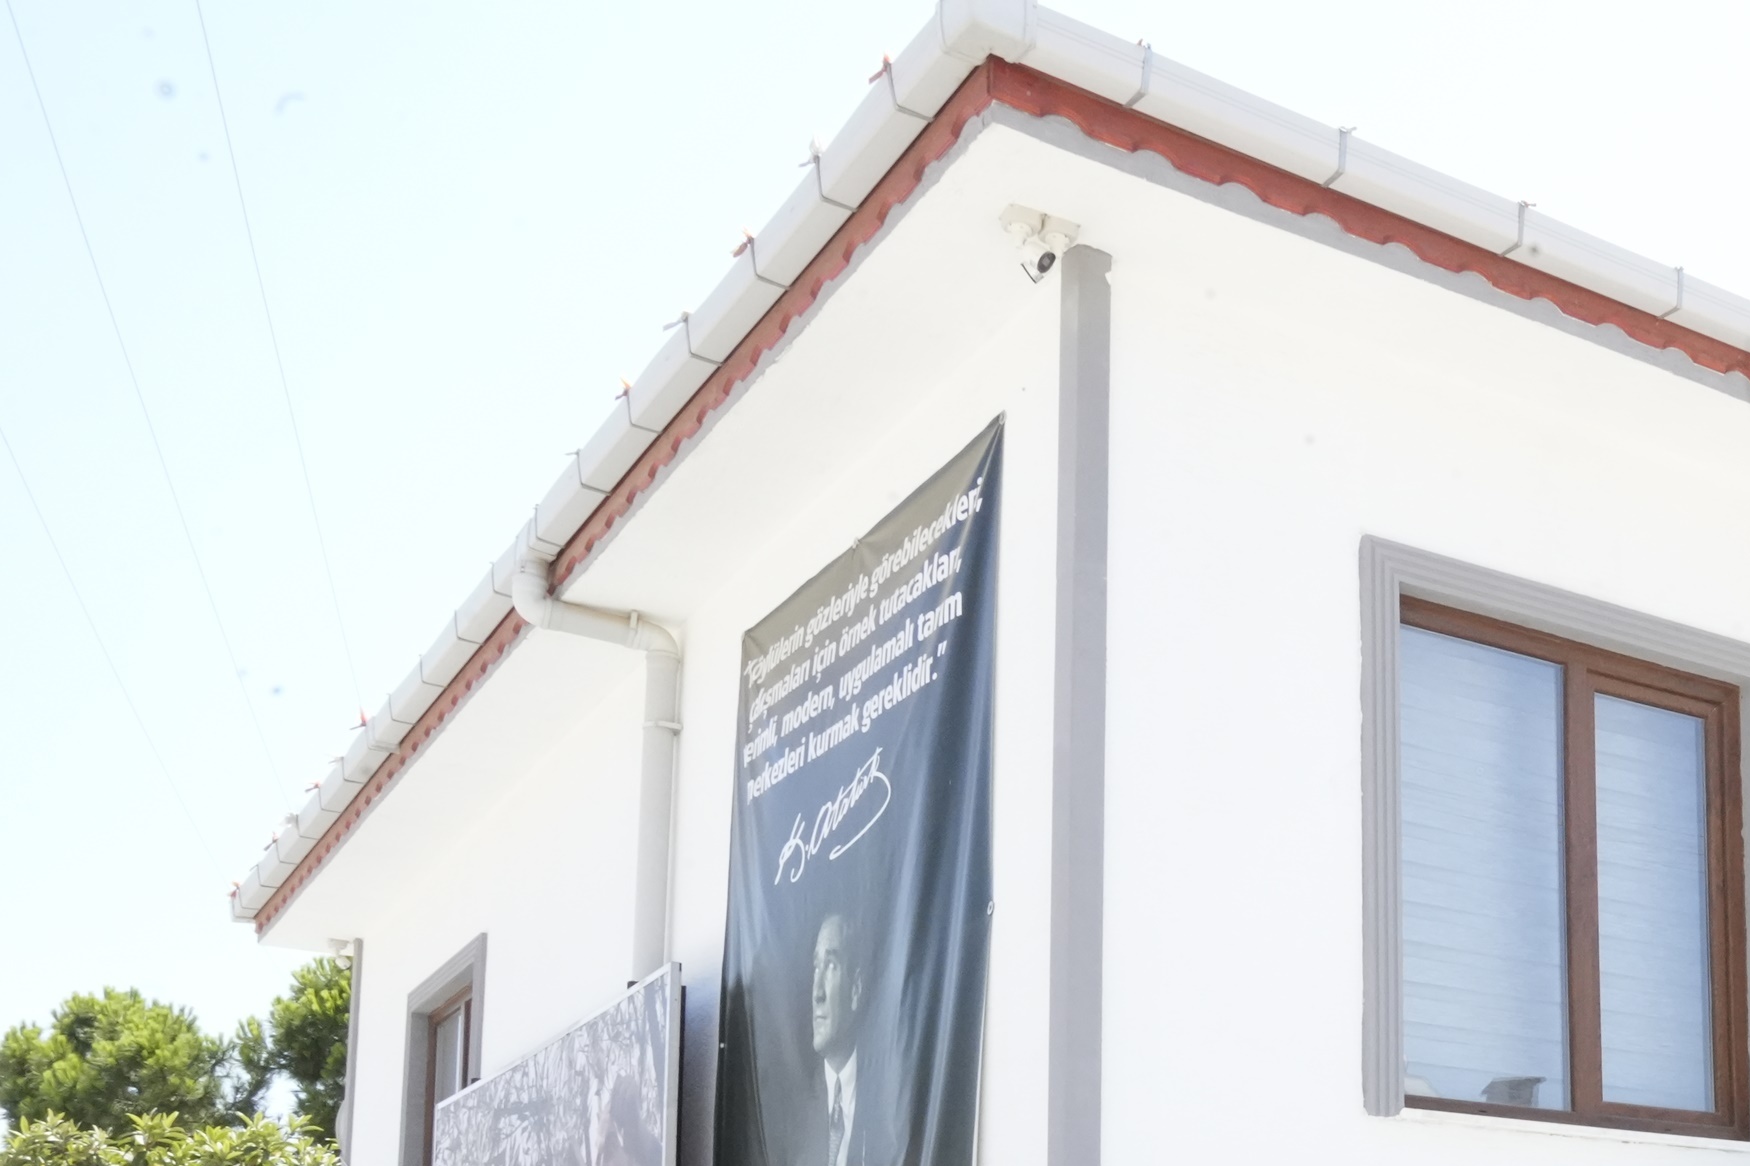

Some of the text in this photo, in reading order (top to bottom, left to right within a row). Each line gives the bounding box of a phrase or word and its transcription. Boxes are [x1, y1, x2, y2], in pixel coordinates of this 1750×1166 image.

[805, 574, 869, 648] gözleriyle
[869, 477, 983, 598] görebilecekleri,
[781, 691, 835, 738] modern,
[839, 617, 914, 702] uygulamalı
[918, 590, 963, 642] tarım
[812, 639, 837, 683] için
[838, 604, 877, 657] örnek
[807, 703, 860, 763] kurmak
